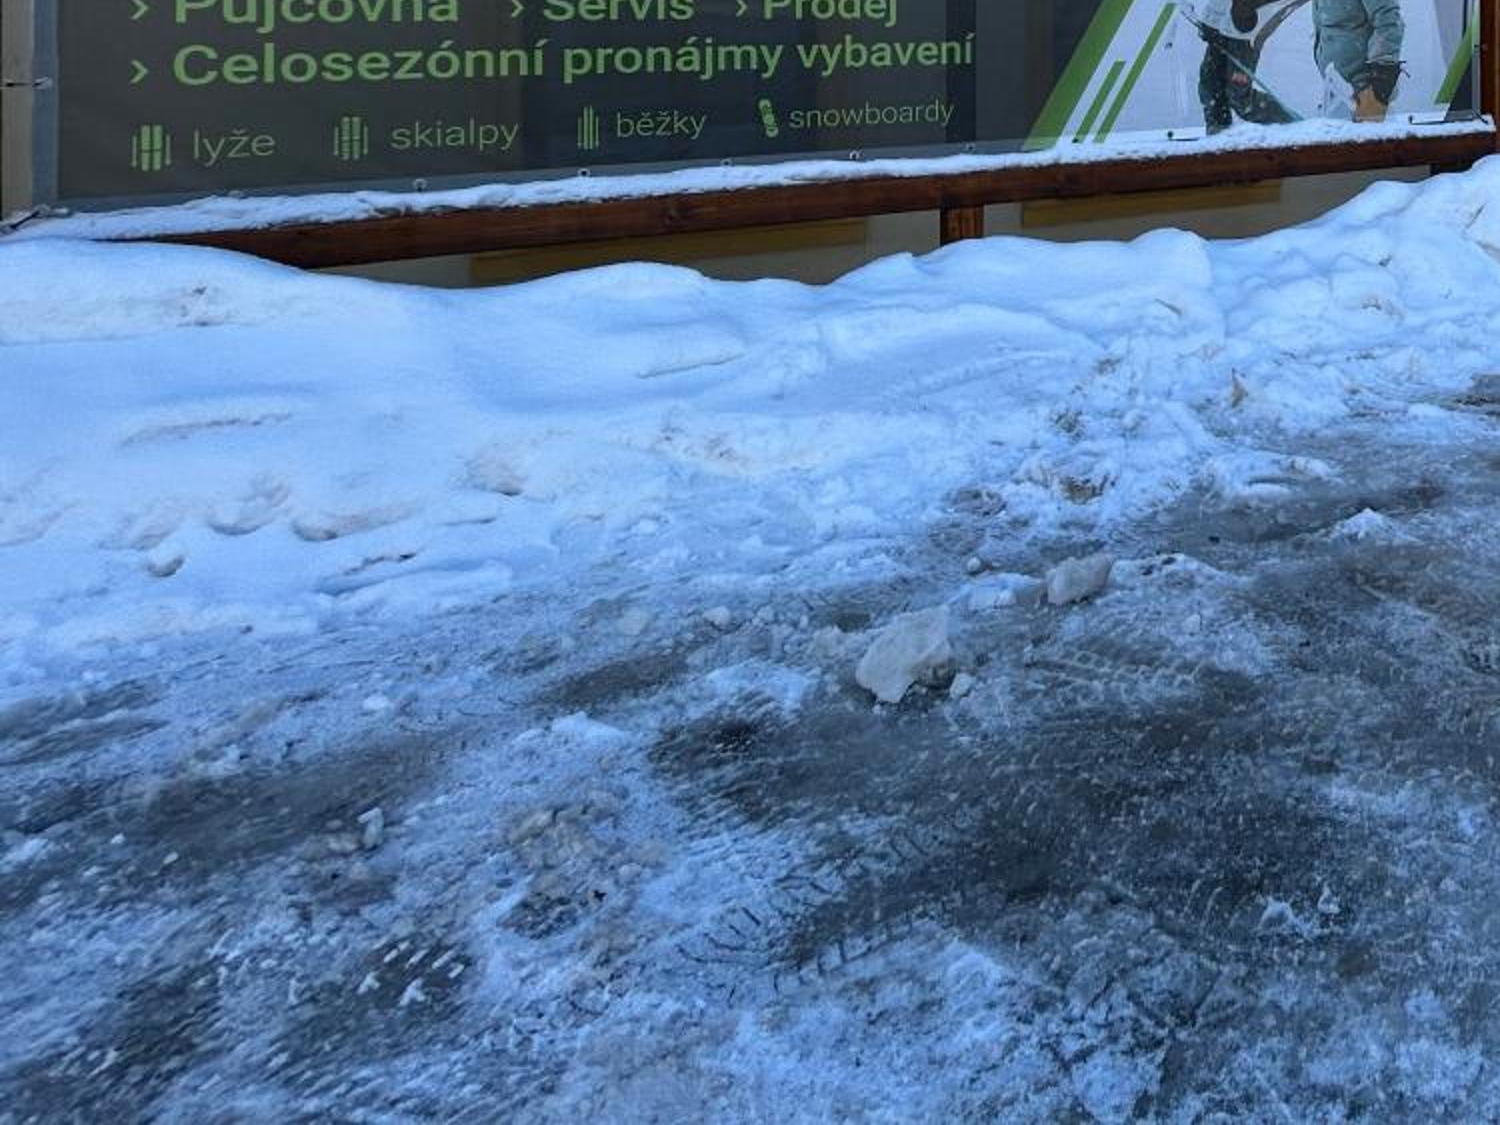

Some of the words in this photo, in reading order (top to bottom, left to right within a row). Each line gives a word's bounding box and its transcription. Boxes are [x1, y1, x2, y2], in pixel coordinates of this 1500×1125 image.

[173, 38, 548, 85] Celosezónní
[563, 37, 783, 84] pronájmy
[796, 33, 976, 76] vybavení
[192, 127, 276, 161] lyže
[390, 117, 519, 152] skialpy
[615, 110, 707, 141] běžky
[788, 98, 955, 131] snowboardy
